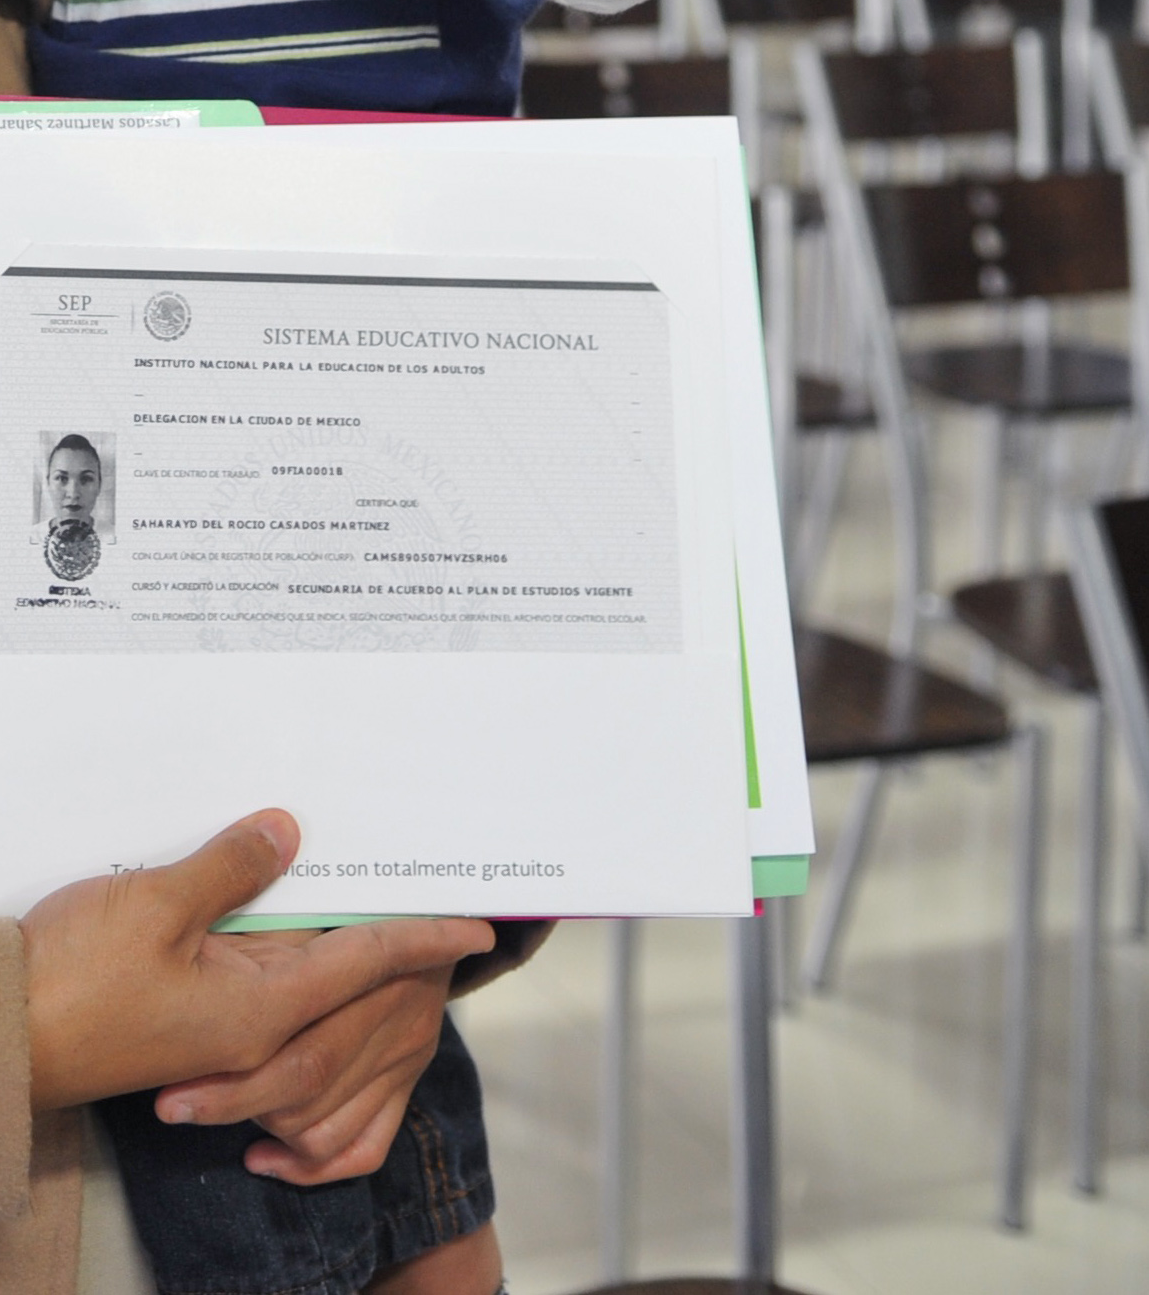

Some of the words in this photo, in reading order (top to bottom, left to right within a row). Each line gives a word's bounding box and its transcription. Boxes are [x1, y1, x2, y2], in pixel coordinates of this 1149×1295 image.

[58, 294, 92, 311] SEP
[262, 327, 351, 346] SISTEMA
[356, 329, 480, 349] EDUCATIVO
[486, 332, 599, 351] NACIONAL
[134, 358, 196, 369] INSTITUTO
[200, 359, 258, 370] NACIONAL
[263, 361, 294, 371] PARA
[299, 362, 313, 372] LA
[318, 362, 385, 373] EDUCACION
[388, 364, 402, 373] DE
[407, 365, 428, 374] LOS
[433, 365, 486, 375] ADULTOS
[134, 413, 207, 424] DELEGACION
[211, 414, 226, 424] EN
[229, 415, 243, 425] LA
[248, 415, 293, 426] CIUDAD
[297, 417, 312, 426] DE
[316, 417, 361, 427] MEXICO
[134, 469, 160, 478] CLAVE
[161, 469, 171, 478] DE
[173, 469, 207, 478] CENTRO
[209, 470, 219, 478] DE
[354, 498, 398, 508] CERTIFICA
[132, 518, 198, 530] SAHARAYD
[202, 519, 224, 530] DEL
[228, 520, 266, 530] ROCIO
[270, 520, 326, 531] CASADOS
[330, 521, 390, 531] MARTINEZ
[132, 551, 151, 561] CON
[152, 551, 179, 561] CLAVE
[208, 552, 219, 561] DE
[220, 552, 261, 562] REGISTRO
[263, 552, 274, 562] DE
[363, 552, 508, 564] CAMS890507MVZSRH06
[131, 580, 162, 592] CURSÓ
[163, 582, 170, 591] Y
[171, 580, 214, 592] ACREDITÓ
[215, 582, 226, 591] LA
[228, 581, 279, 592] EDUCACIÓN
[288, 584, 363, 595] SECUNDARIA
[368, 585, 383, 595] DE
[388, 586, 444, 596] ACUERDO
[448, 586, 463, 596] AL
[467, 586, 499, 596] PLAN
[502, 586, 517, 596] DE
[522, 587, 581, 597] ESTUDIOS
[584, 587, 633, 597] VIGENTE
[131, 612, 150, 622] CON
[152, 612, 161, 621] EL
[162, 612, 206, 622] PROMEDIO
[207, 612, 218, 622] DE
[552, 614, 563, 623] DE
[565, 614, 607, 624] CONTROL
[336, 863, 369, 878] son
[373, 859, 477, 878] totalmente
[481, 859, 565, 882] gratuitos
